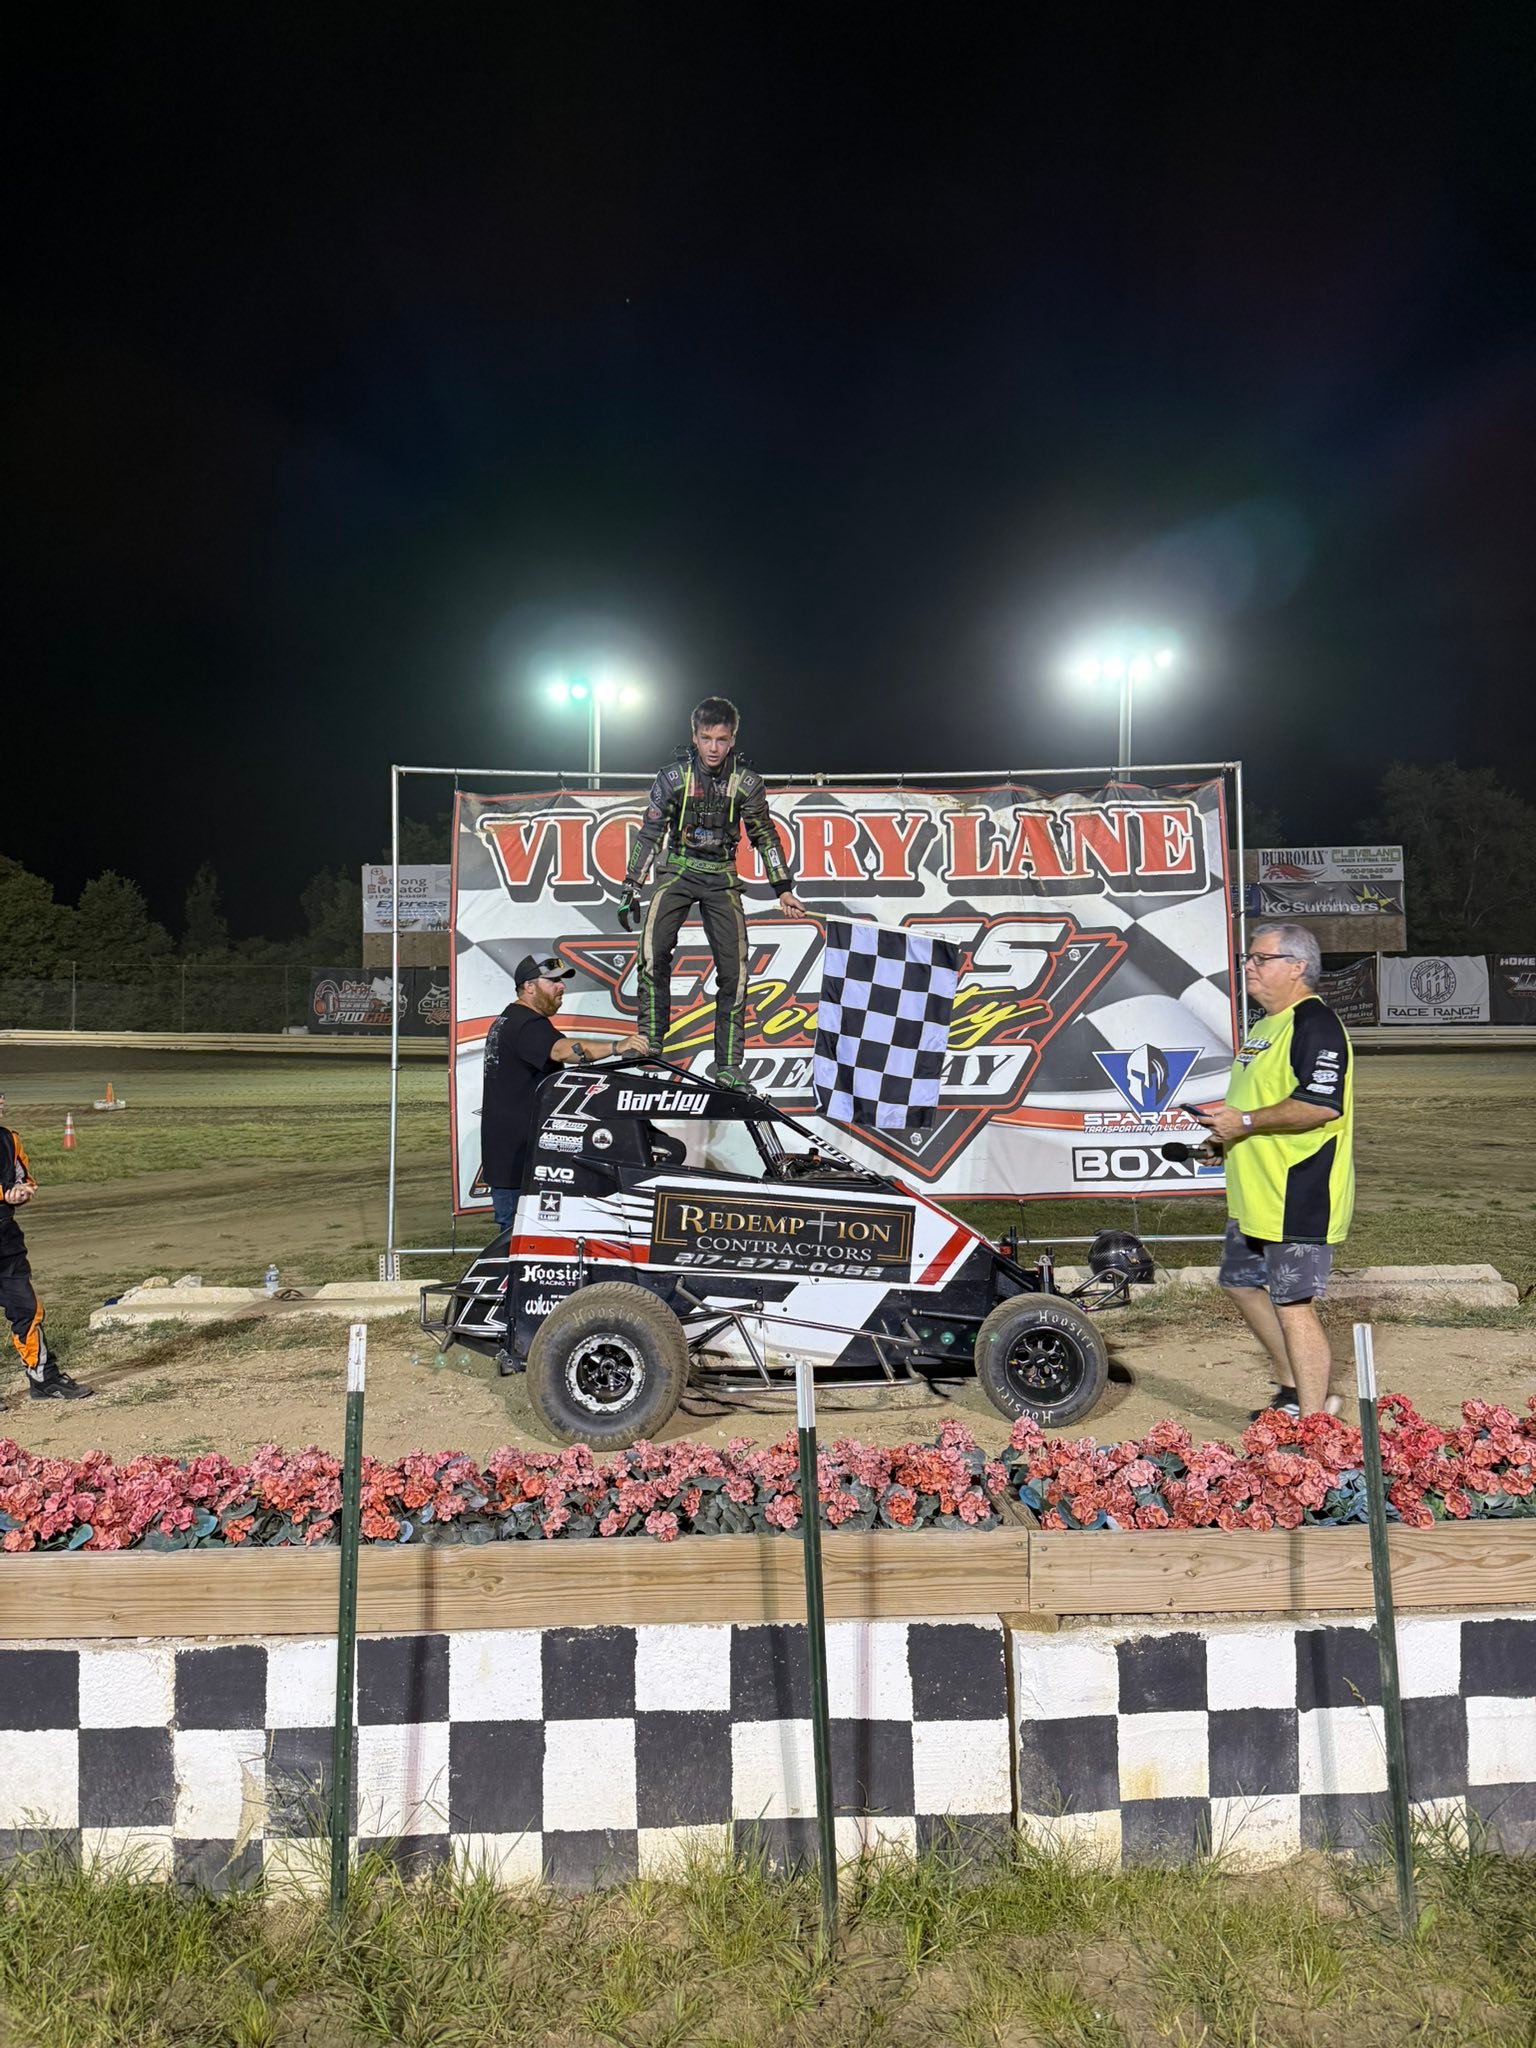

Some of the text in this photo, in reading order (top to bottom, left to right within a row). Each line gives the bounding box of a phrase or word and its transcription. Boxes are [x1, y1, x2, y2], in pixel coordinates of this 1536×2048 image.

[482, 812, 929, 886] VICORY
[944, 807, 1198, 879] LANE
[1261, 850, 1325, 866] BURROMAX
[1331, 848, 1401, 863] CLEVELAND
[367, 884, 429, 894] Eleator
[1265, 900, 1379, 913] KC Summers
[1387, 1006, 1480, 1017] RACE RANCH
[616, 1090, 711, 1115] Bartley
[1084, 1111, 1200, 1126] SPARTA
[1084, 1123, 1163, 1134] TRANSPORTATION
[534, 1165, 575, 1180] EVO
[696, 1235, 872, 1262] CONTRACTORS
[674, 1251, 885, 1277] 217-273-0452
[519, 1263, 589, 1283] Hoosier
[573, 1305, 644, 1327] Hoosier
